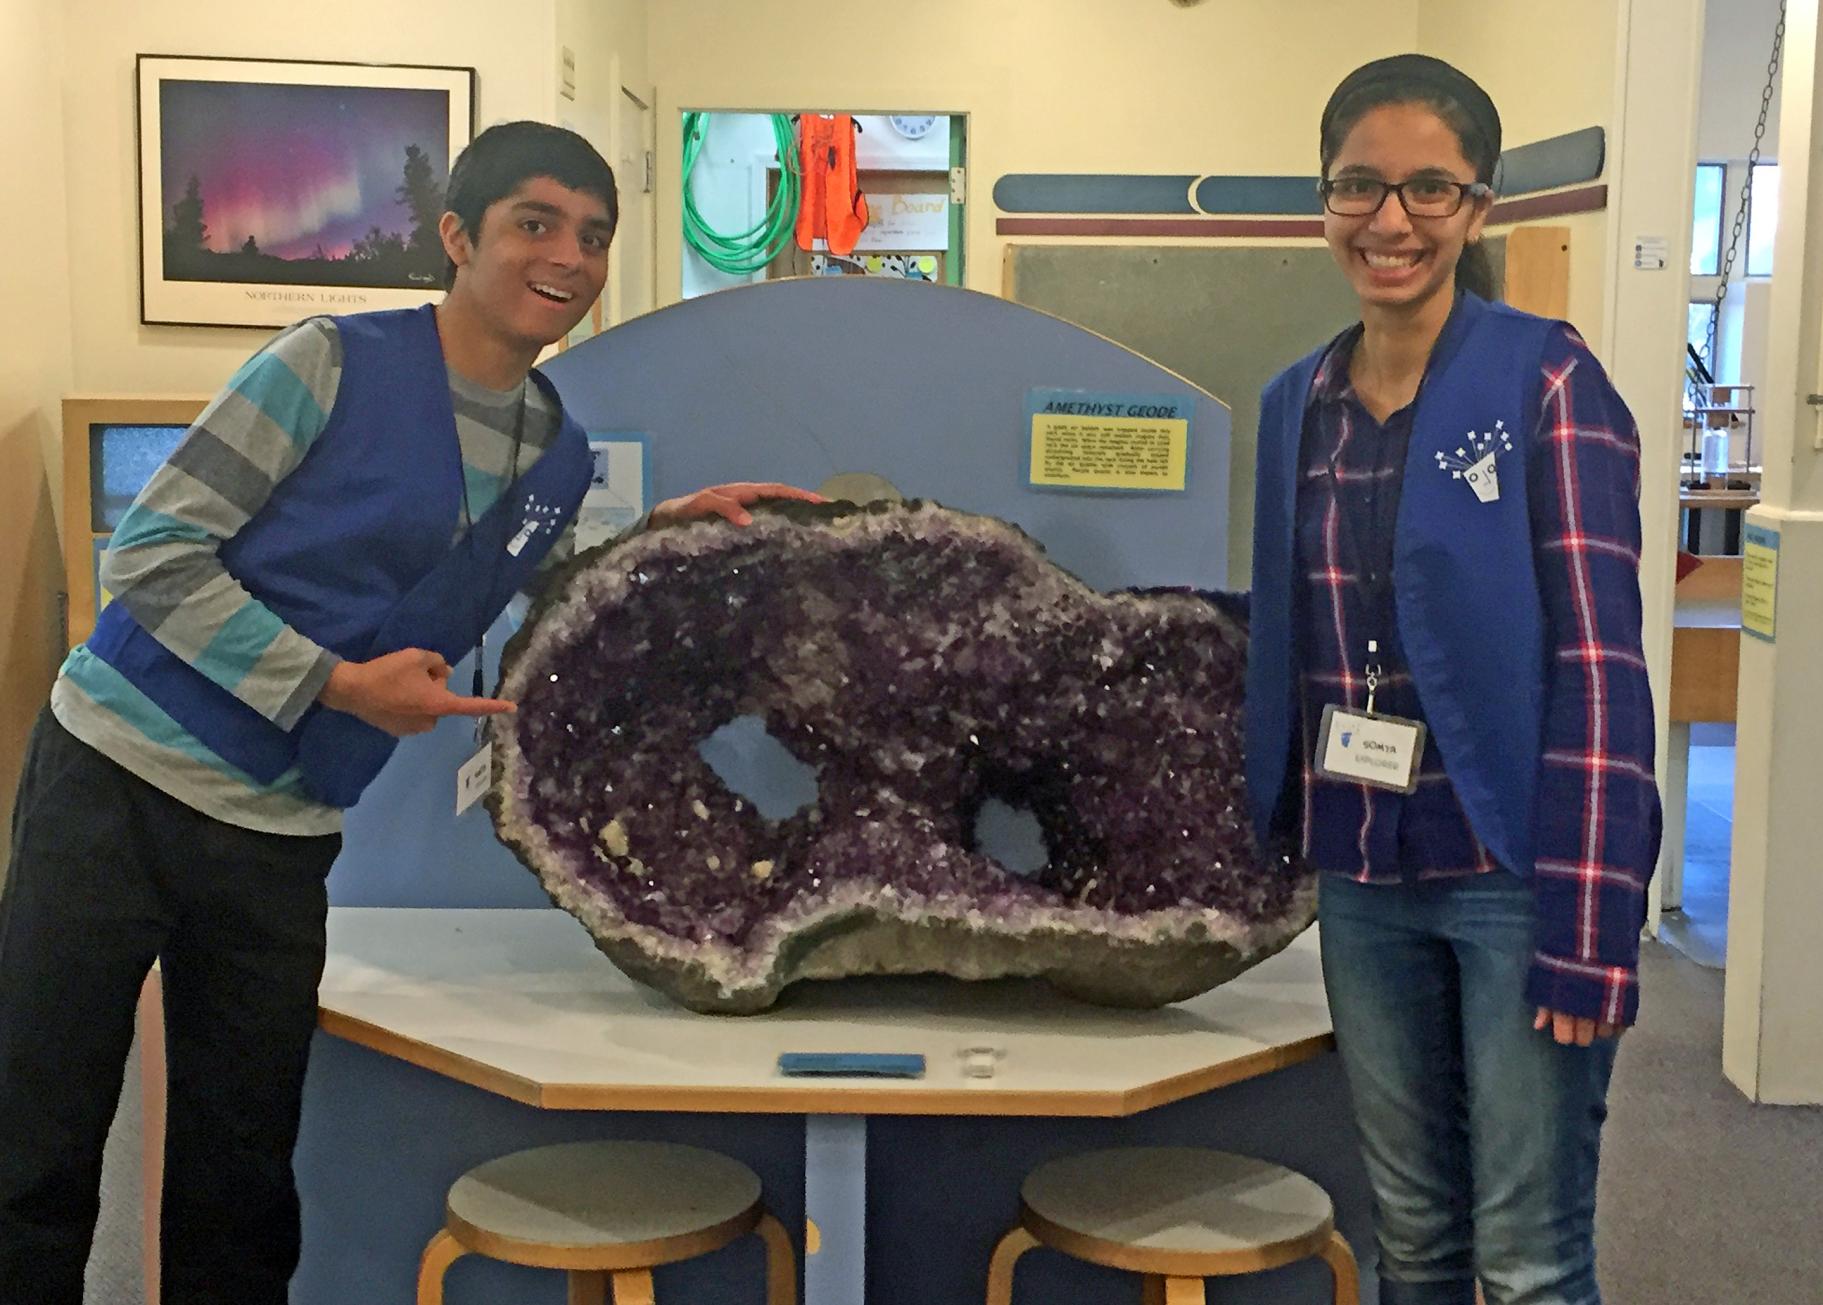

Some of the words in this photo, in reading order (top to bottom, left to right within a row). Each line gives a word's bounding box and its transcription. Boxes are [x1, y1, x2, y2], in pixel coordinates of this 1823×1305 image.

[245, 290, 315, 302] NORTHERN
[320, 293, 368, 303] LIGHTS
[1044, 401, 1124, 416] AMETHYST
[1127, 404, 1178, 418] GEODE
